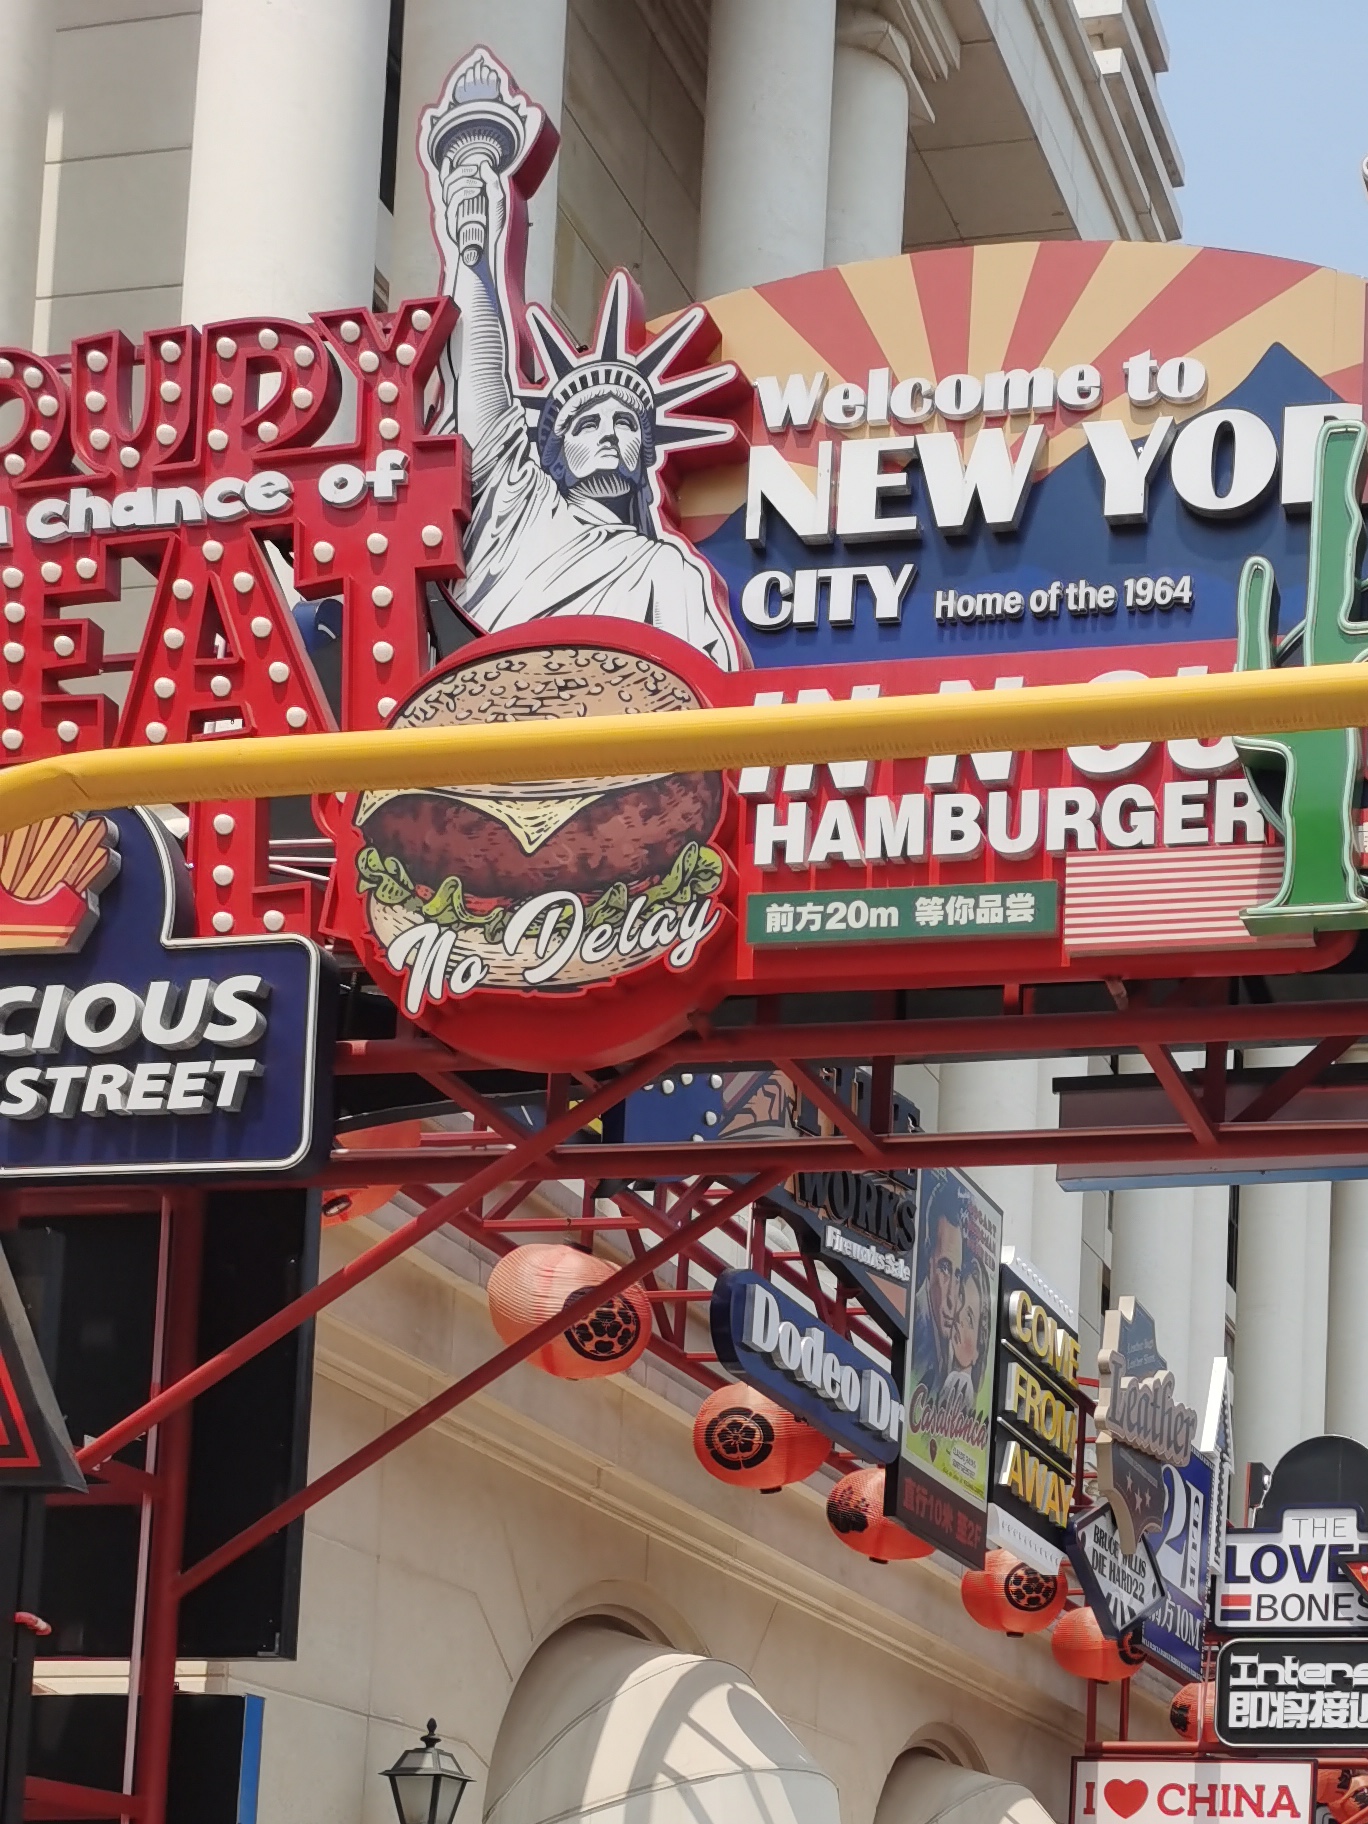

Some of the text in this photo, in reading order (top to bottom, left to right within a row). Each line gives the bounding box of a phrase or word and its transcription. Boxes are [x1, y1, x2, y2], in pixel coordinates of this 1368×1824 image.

[759, 348, 1208, 432] Welcome to
[26, 470, 294, 541] chance
[319, 450, 408, 507] of
[745, 402, 1364, 546] NEW YO
[741, 564, 1194, 632] CITY Home of the 1964
[754, 780, 1268, 870] HAMBURGER
[389, 890, 720, 1015] No Delay
[766, 891, 1036, 934] 前方20m 等你品尝
[4, 1058, 262, 1121] STREET
[800, 1170, 917, 1252] WORKS
[1007, 1288, 1080, 1389] COME
[909, 1382, 989, 1451] Casablanca
[1006, 1361, 1078, 1454] FROM
[1107, 1360, 1197, 1461] Leather
[1000, 1440, 1075, 1528] AWAY
[1292, 1516, 1347, 1538] THE
[1083, 1781, 1302, 1818] I CHINA
